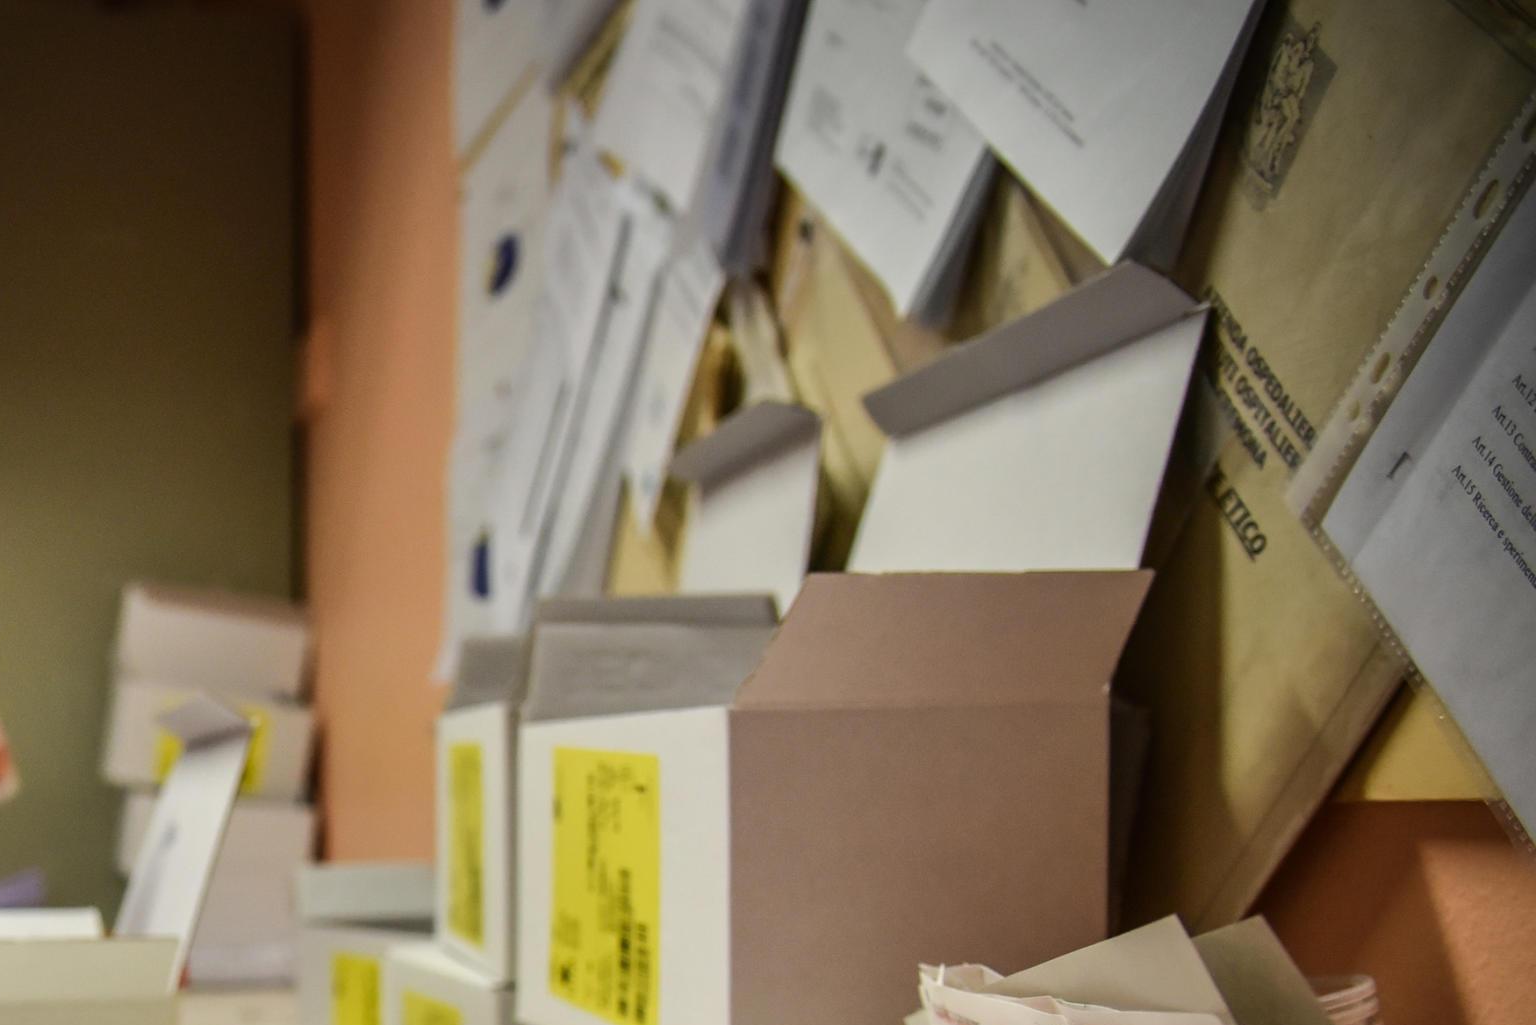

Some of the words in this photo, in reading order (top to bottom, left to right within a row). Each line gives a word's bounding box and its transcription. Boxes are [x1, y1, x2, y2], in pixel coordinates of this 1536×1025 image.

[1491, 405, 1517, 438] Art.13
[1451, 463, 1476, 497] Art.15
[1472, 493, 1499, 532] Ricerca
[1471, 435, 1496, 467] Art.14
[1492, 463, 1523, 507] Gestione
